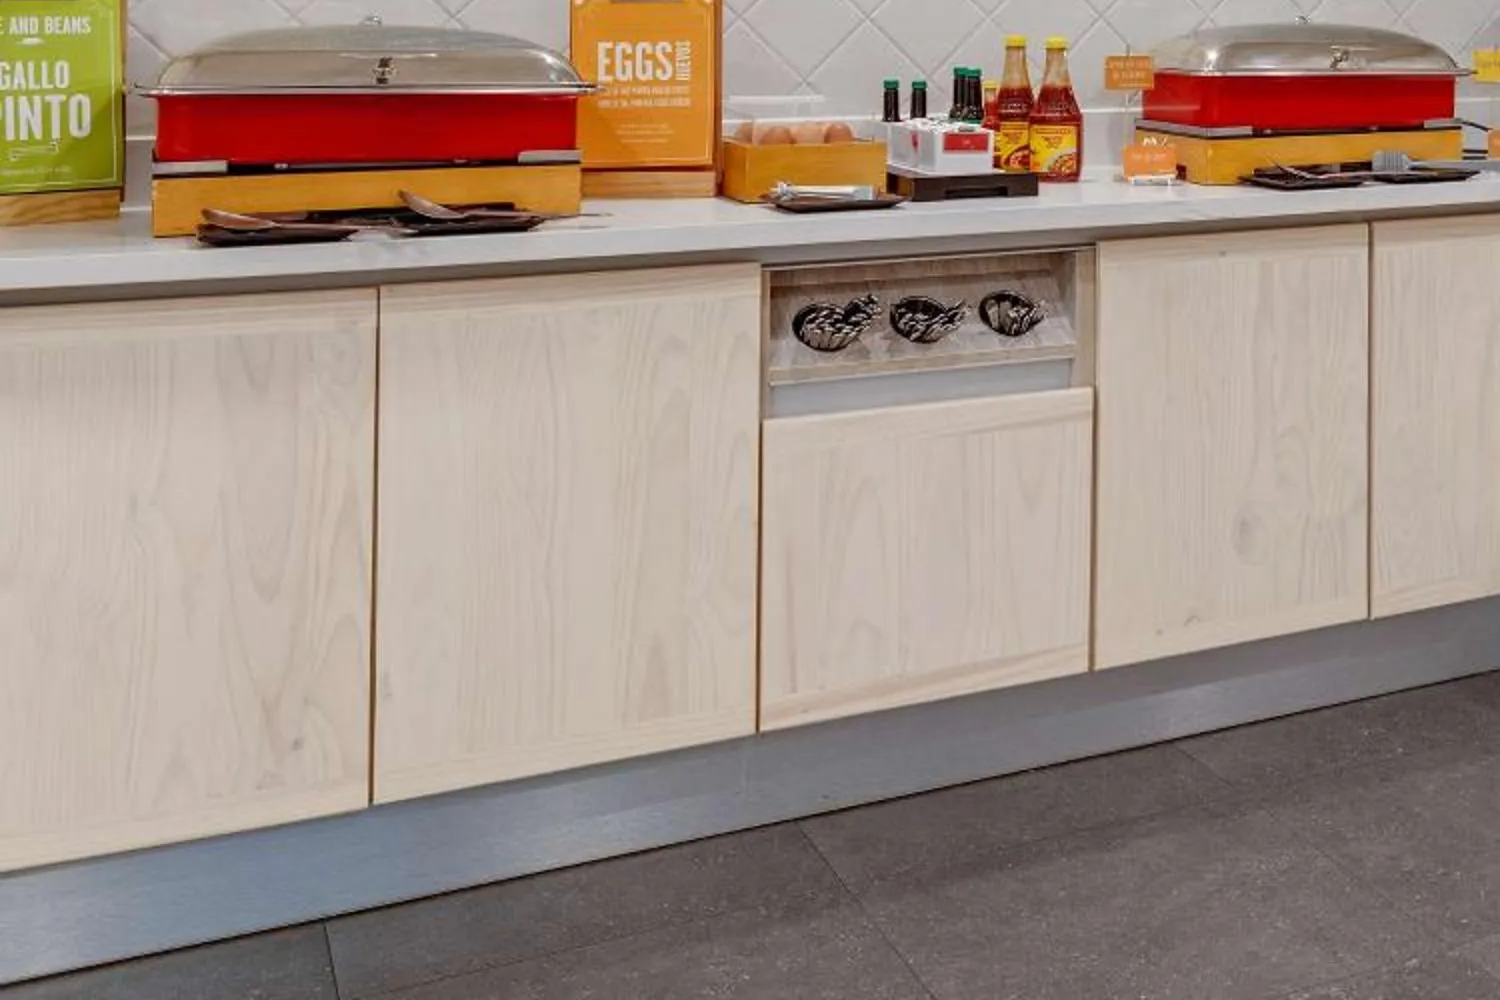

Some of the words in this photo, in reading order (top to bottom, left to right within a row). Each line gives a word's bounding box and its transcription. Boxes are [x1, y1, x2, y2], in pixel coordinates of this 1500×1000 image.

[9, 15, 39, 35] AND
[44, 15, 91, 35] BEANS
[0, 60, 70, 90] GALLO
[597, 41, 673, 83] EGGS
[0, 93, 91, 141] INTO
